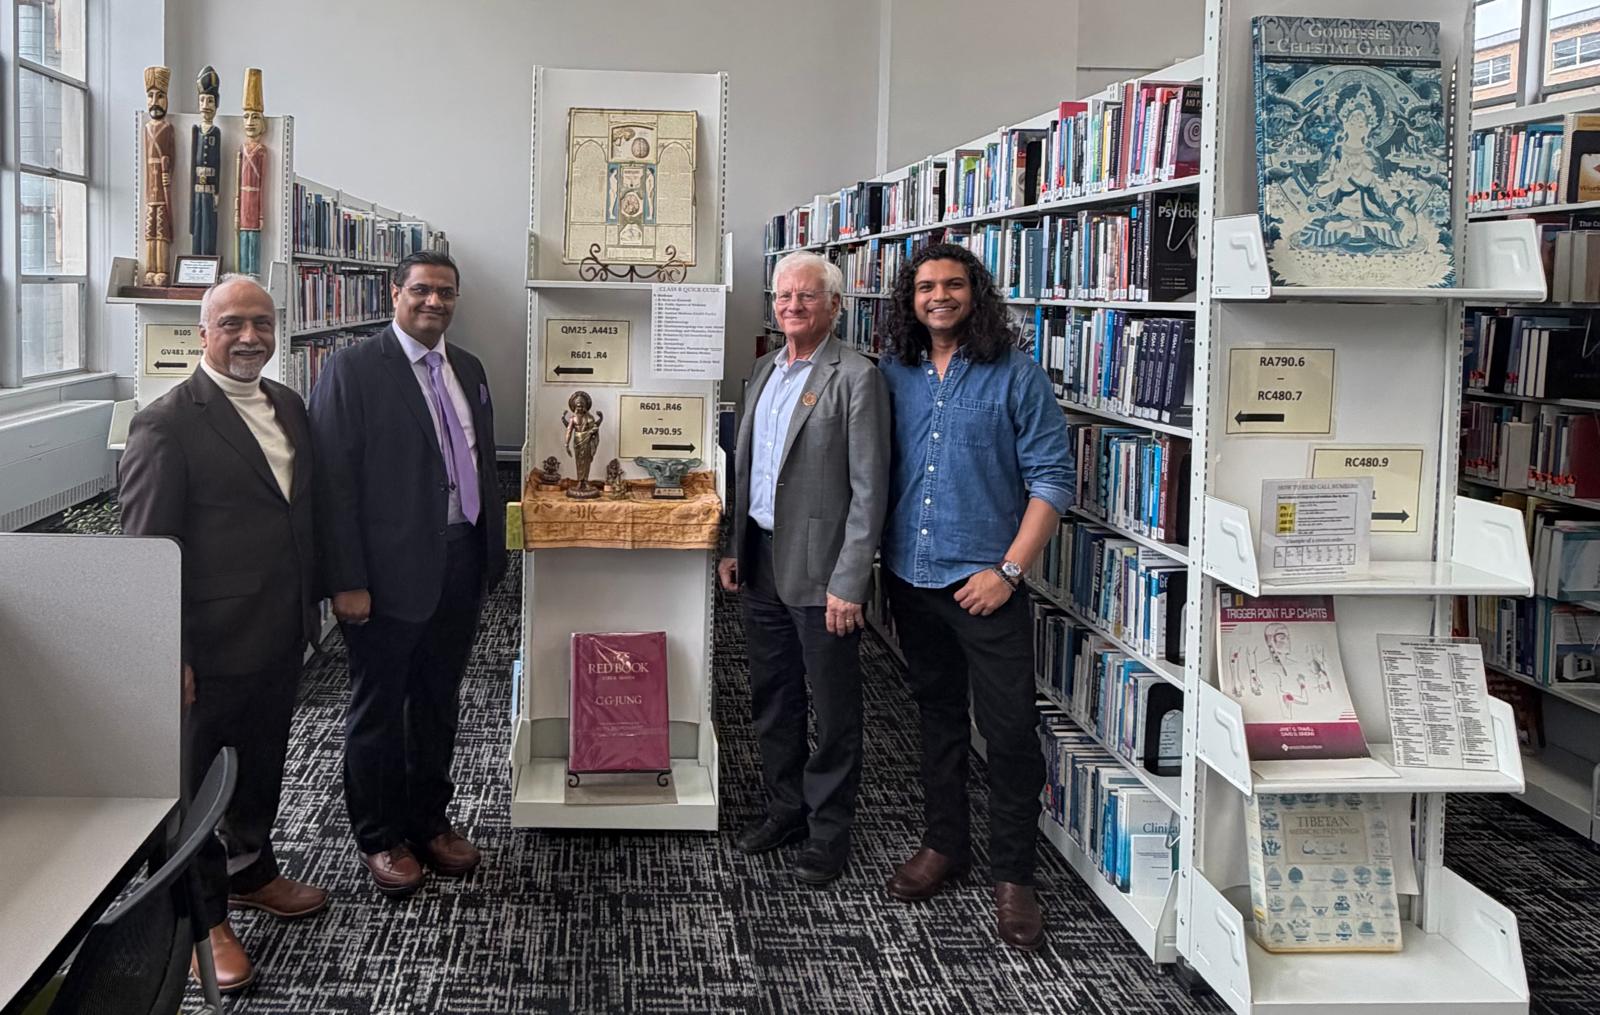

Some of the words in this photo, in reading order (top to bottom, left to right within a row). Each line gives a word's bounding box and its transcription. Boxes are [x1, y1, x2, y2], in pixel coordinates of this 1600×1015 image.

[561, 326, 587, 335] QM25
[589, 326, 618, 335] .A4413
[570, 351, 591, 359] R601
[593, 351, 608, 359] .R4
[1260, 357, 1305, 367] RA790.6
[1258, 391, 1302, 401] RC480.7
[640, 403, 661, 411] R601
[663, 403, 682, 411] .R46
[642, 428, 682, 436] RA790.95
[1344, 457, 1388, 468] RC480.9
[1226, 608, 1256, 619] TRIGGER
[1258, 608, 1279, 618] POINT
[1280, 608, 1296, 618] FLIP
[1297, 608, 1327, 618] CHARTS
[588, 663, 613, 674] RED
[615, 662, 649, 674] BOOK
[1296, 816, 1350, 827] TIBETAN
